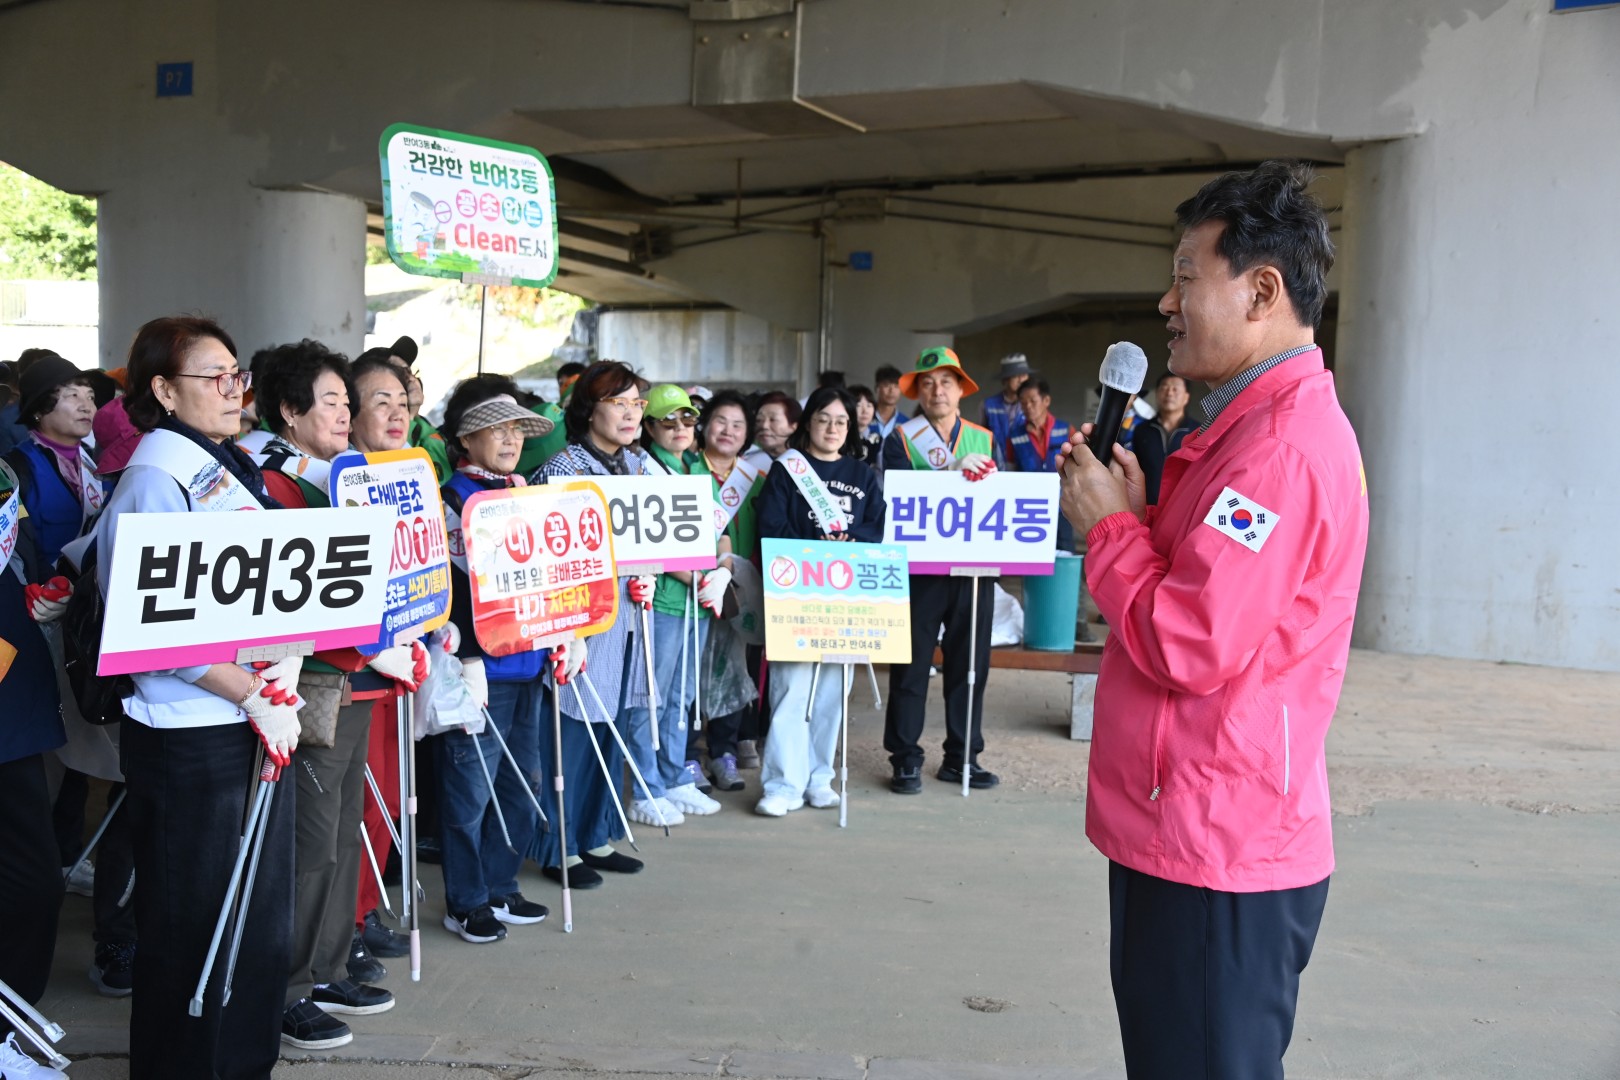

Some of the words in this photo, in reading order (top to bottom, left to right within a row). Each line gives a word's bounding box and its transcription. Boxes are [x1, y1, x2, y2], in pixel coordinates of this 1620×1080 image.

[166, 71, 183, 88] P7
[403, 137, 431, 150] 반여3동
[408, 151, 463, 180] 건강한
[469, 159, 539, 195] 반여3동
[342, 472, 363, 487] 반여3동
[480, 503, 509, 519] 반여3동
[609, 492, 703, 544] 여3동
[892, 496, 1052, 543] 반여4동
[137, 534, 372, 624] 반여3동
[408, 566, 448, 603] 쓰레기통에
[495, 570, 511, 594] 내
[513, 568, 527, 590] 집
[530, 566, 543, 587] 앞
[546, 557, 604, 584] 담배꽁초는
[801, 559, 854, 591] NO
[856, 562, 904, 590] 꽁초
[514, 594, 546, 622] 내가
[549, 583, 591, 614] 치우자
[392, 610, 410, 629] 반여3동
[529, 620, 553, 636] 반여3동
[810, 638, 846, 649] 해운대구
[849, 640, 882, 650] 반여4동
